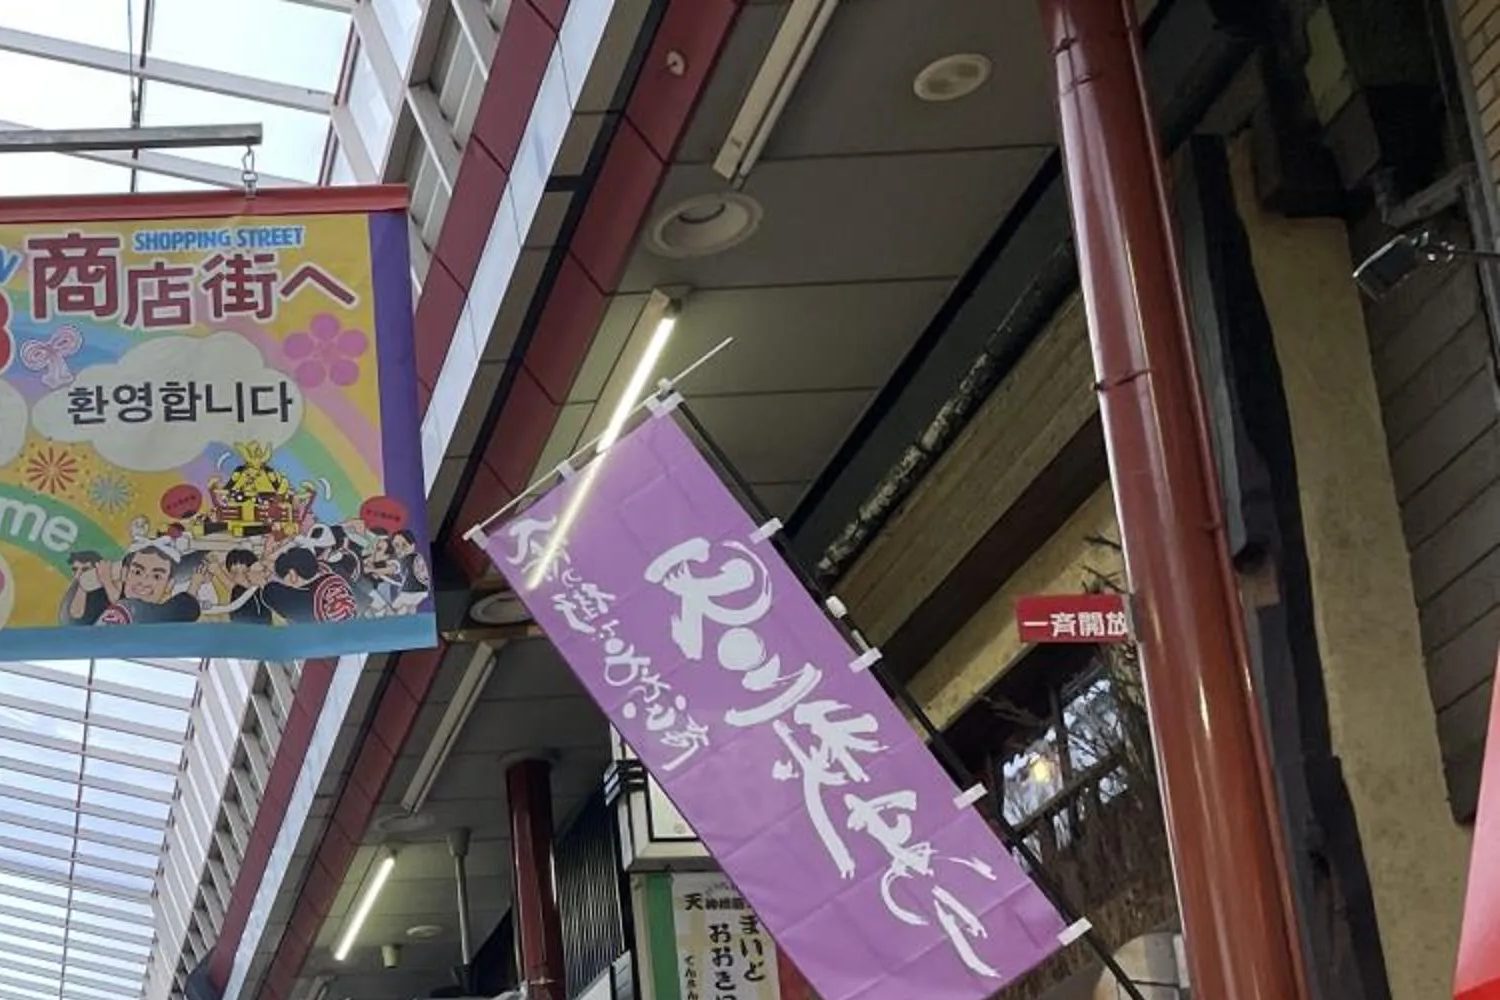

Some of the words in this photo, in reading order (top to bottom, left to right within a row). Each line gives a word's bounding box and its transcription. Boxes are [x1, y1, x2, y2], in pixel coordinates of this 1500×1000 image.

[134, 230, 231, 252] SHOPPING
[237, 226, 305, 248] STREET
[27, 232, 356, 328] 商店街へ
[67, 381, 293, 424] 환영합니다
[1022, 611, 1128, 639] 一斉開放
[738, 914, 766, 982] まいど
